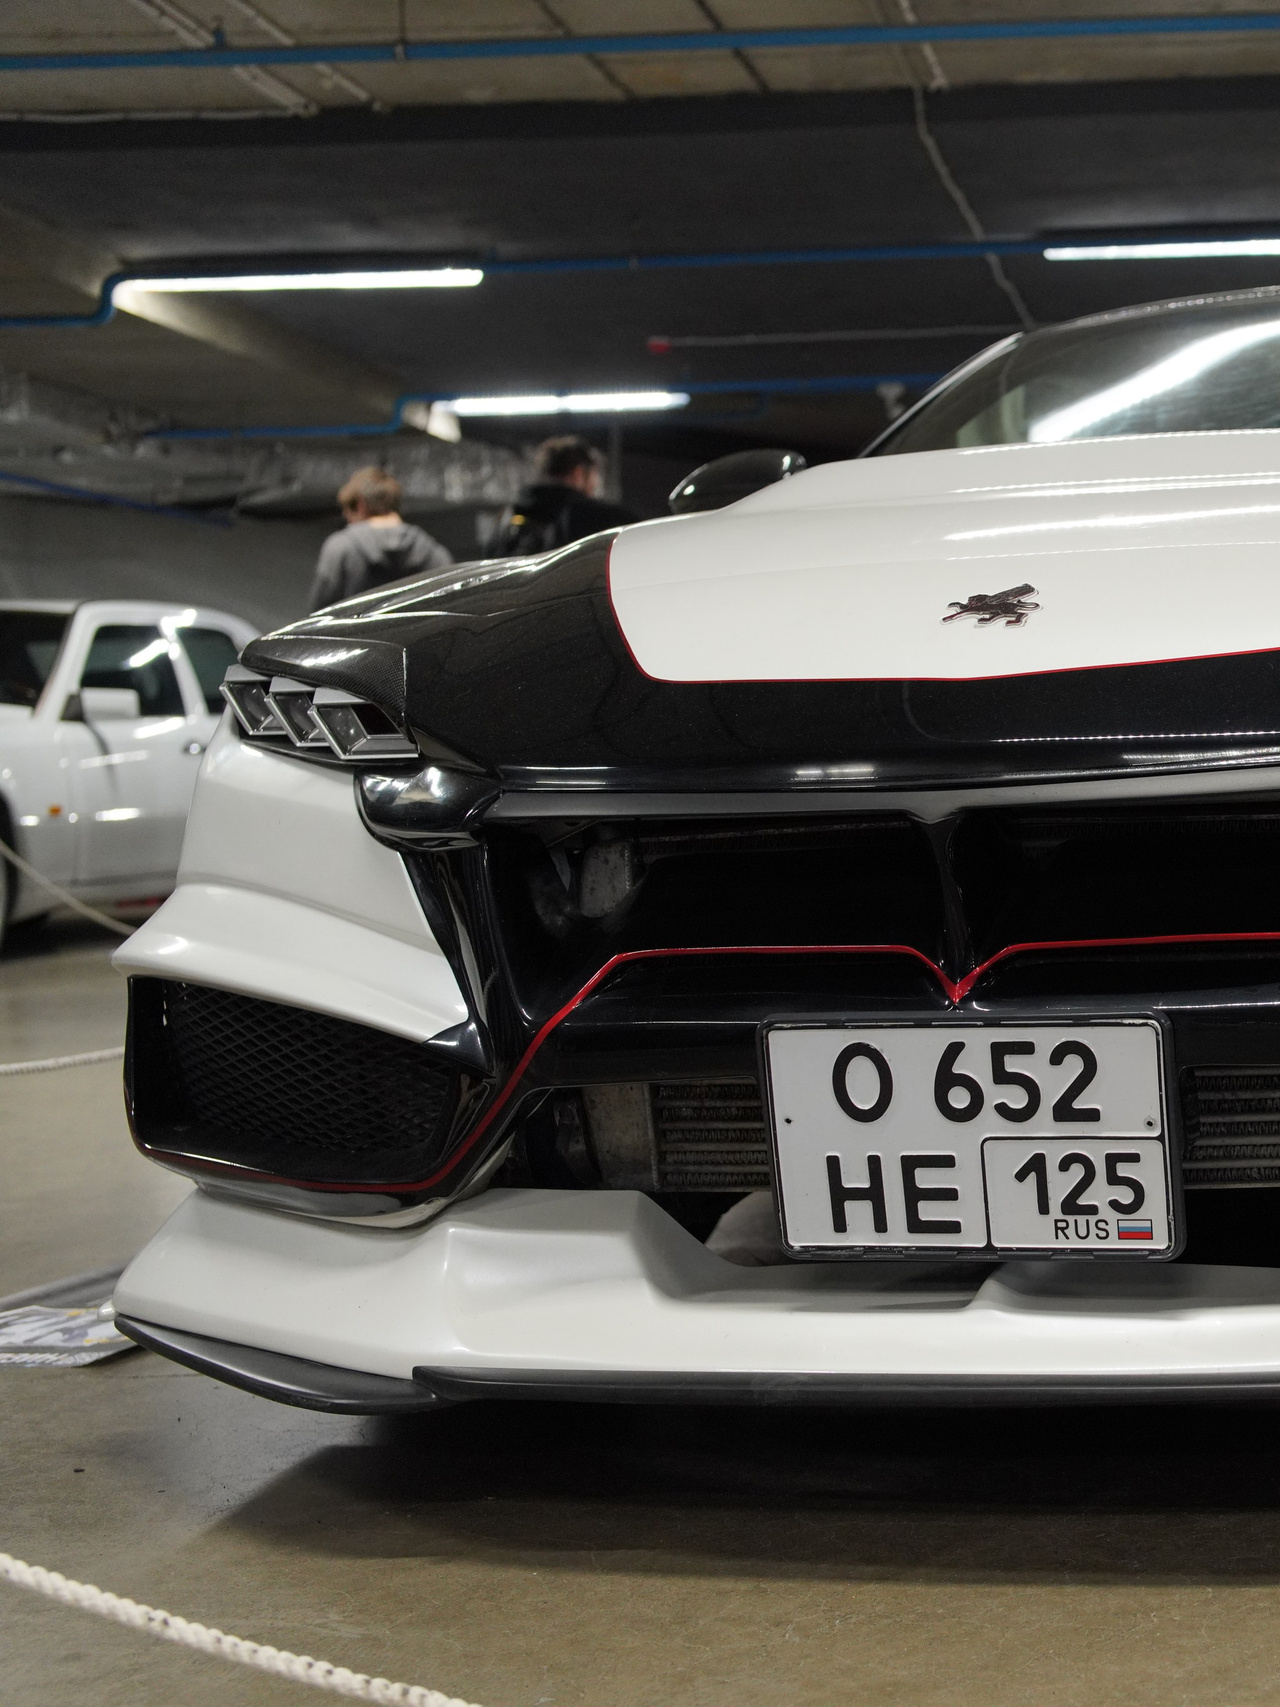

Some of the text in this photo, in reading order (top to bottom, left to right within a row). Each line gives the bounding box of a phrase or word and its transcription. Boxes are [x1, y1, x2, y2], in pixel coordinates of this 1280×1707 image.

[934, 1040, 1101, 1123] 652
[826, 1154, 962, 1234] HE
[1014, 1152, 1146, 1216] 125
[1054, 1219, 1110, 1241] RUS
